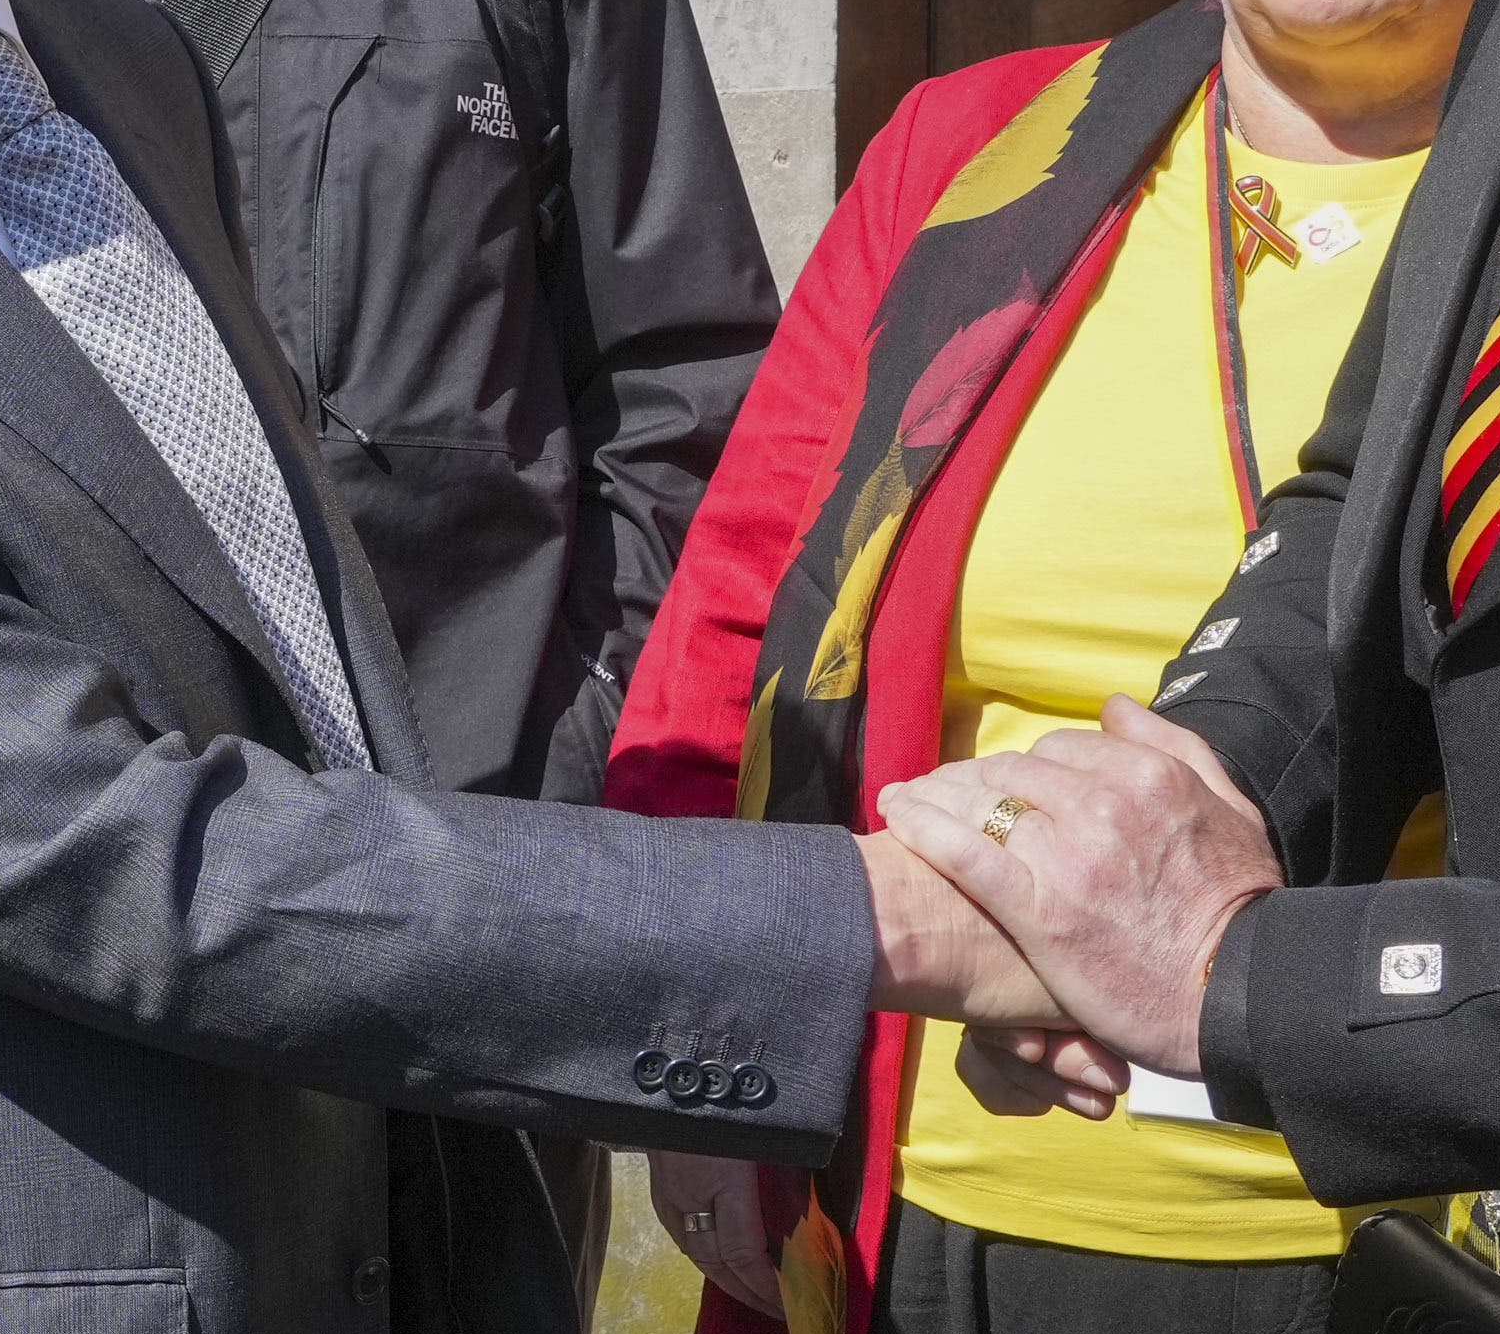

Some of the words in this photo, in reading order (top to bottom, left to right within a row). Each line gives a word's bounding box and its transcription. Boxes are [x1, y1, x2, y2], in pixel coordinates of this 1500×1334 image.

[483, 82, 509, 103] TH
[456, 94, 512, 121] NORTH
[470, 114, 511, 139] FACE
